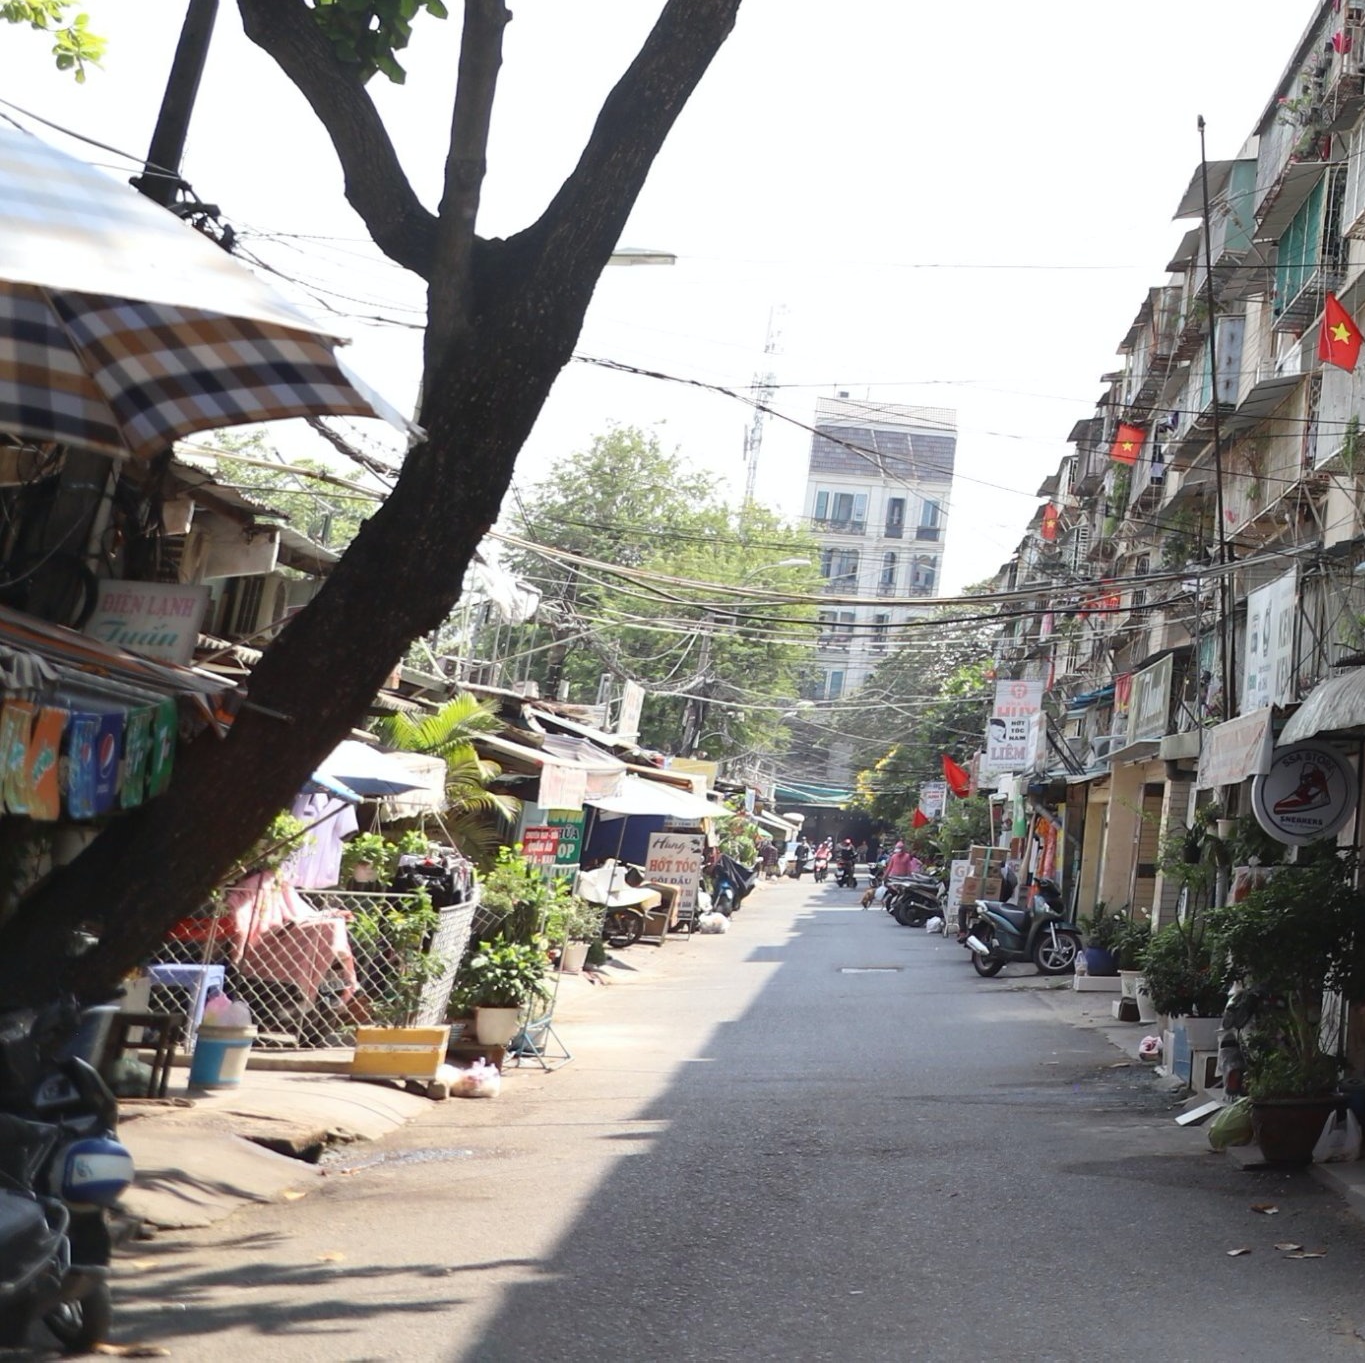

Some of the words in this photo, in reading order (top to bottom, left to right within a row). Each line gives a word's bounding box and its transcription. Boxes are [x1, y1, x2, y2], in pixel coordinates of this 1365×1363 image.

[146, 596, 196, 619] LẠNH
[991, 744, 1026, 760] LIÊM
[1282, 753, 1303, 768] SSA
[1280, 816, 1323, 826] SNEAKERS
[649, 856, 673, 872] HỚT
[674, 857, 697, 873] TÓC
